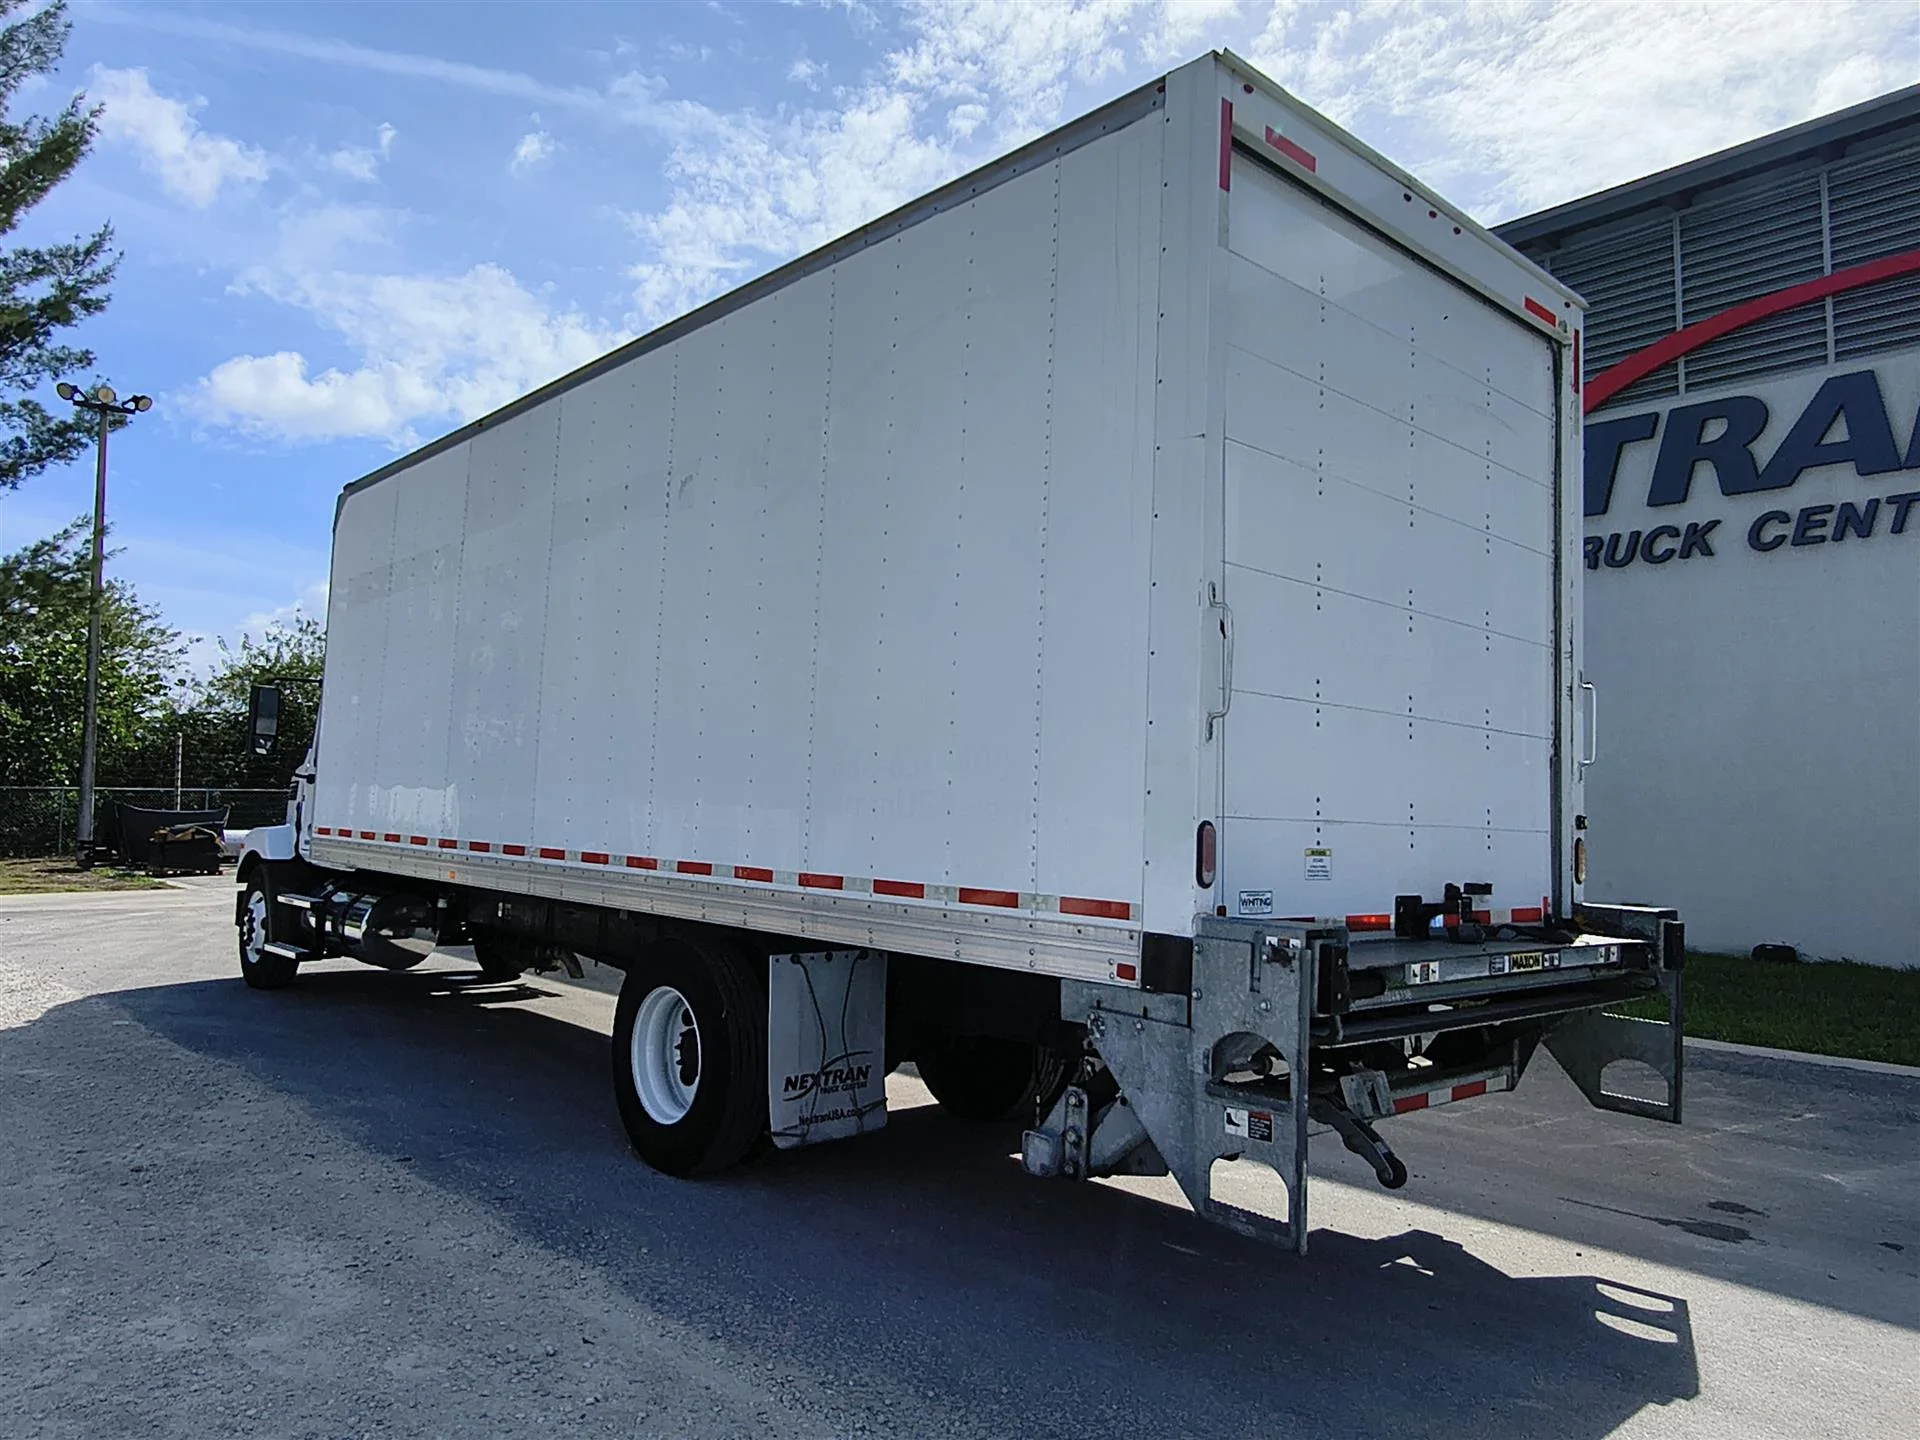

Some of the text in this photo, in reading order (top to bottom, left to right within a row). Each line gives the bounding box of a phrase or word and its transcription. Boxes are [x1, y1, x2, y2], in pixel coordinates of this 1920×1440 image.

[1583, 369, 1920, 517] TRA
[1511, 953, 1541, 970] MAXON
[784, 1065, 871, 1092] NEXTRAN
